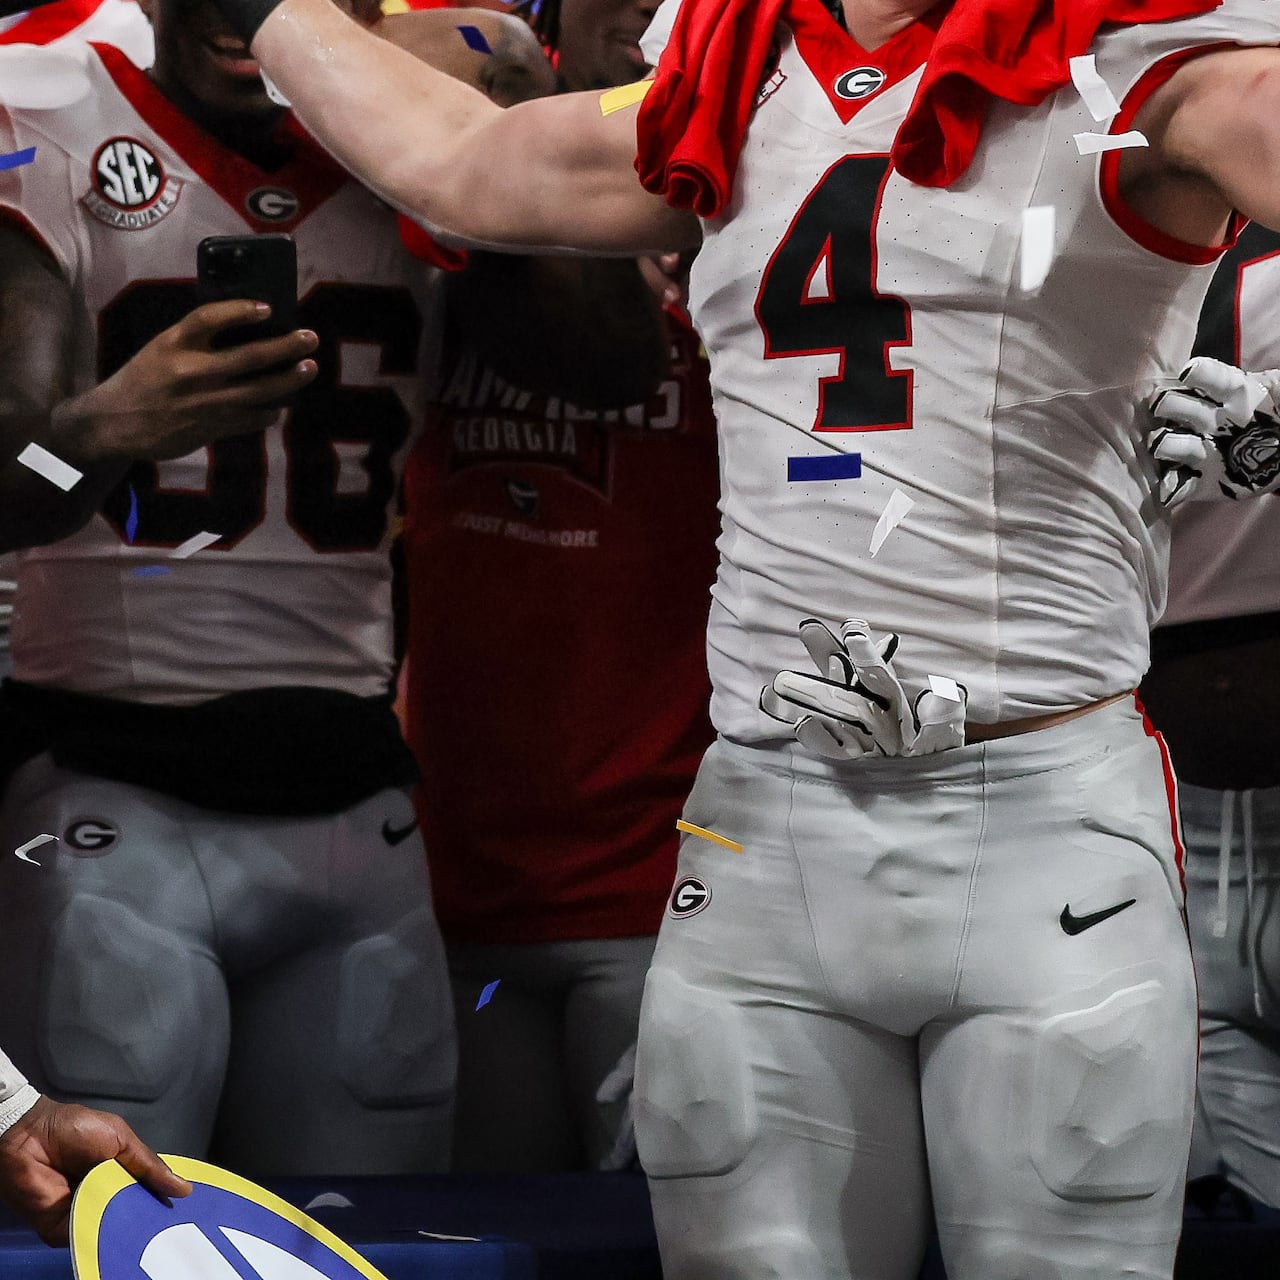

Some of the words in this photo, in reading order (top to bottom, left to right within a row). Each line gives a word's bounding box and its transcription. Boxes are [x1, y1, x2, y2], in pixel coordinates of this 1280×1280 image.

[836, 67, 885, 99] G
[97, 141, 160, 206] SEC
[248, 188, 298, 221] G
[754, 152, 914, 432] 4
[453, 419, 577, 455] GEORGIA
[64, 820, 117, 850] G
[671, 879, 707, 912] G
